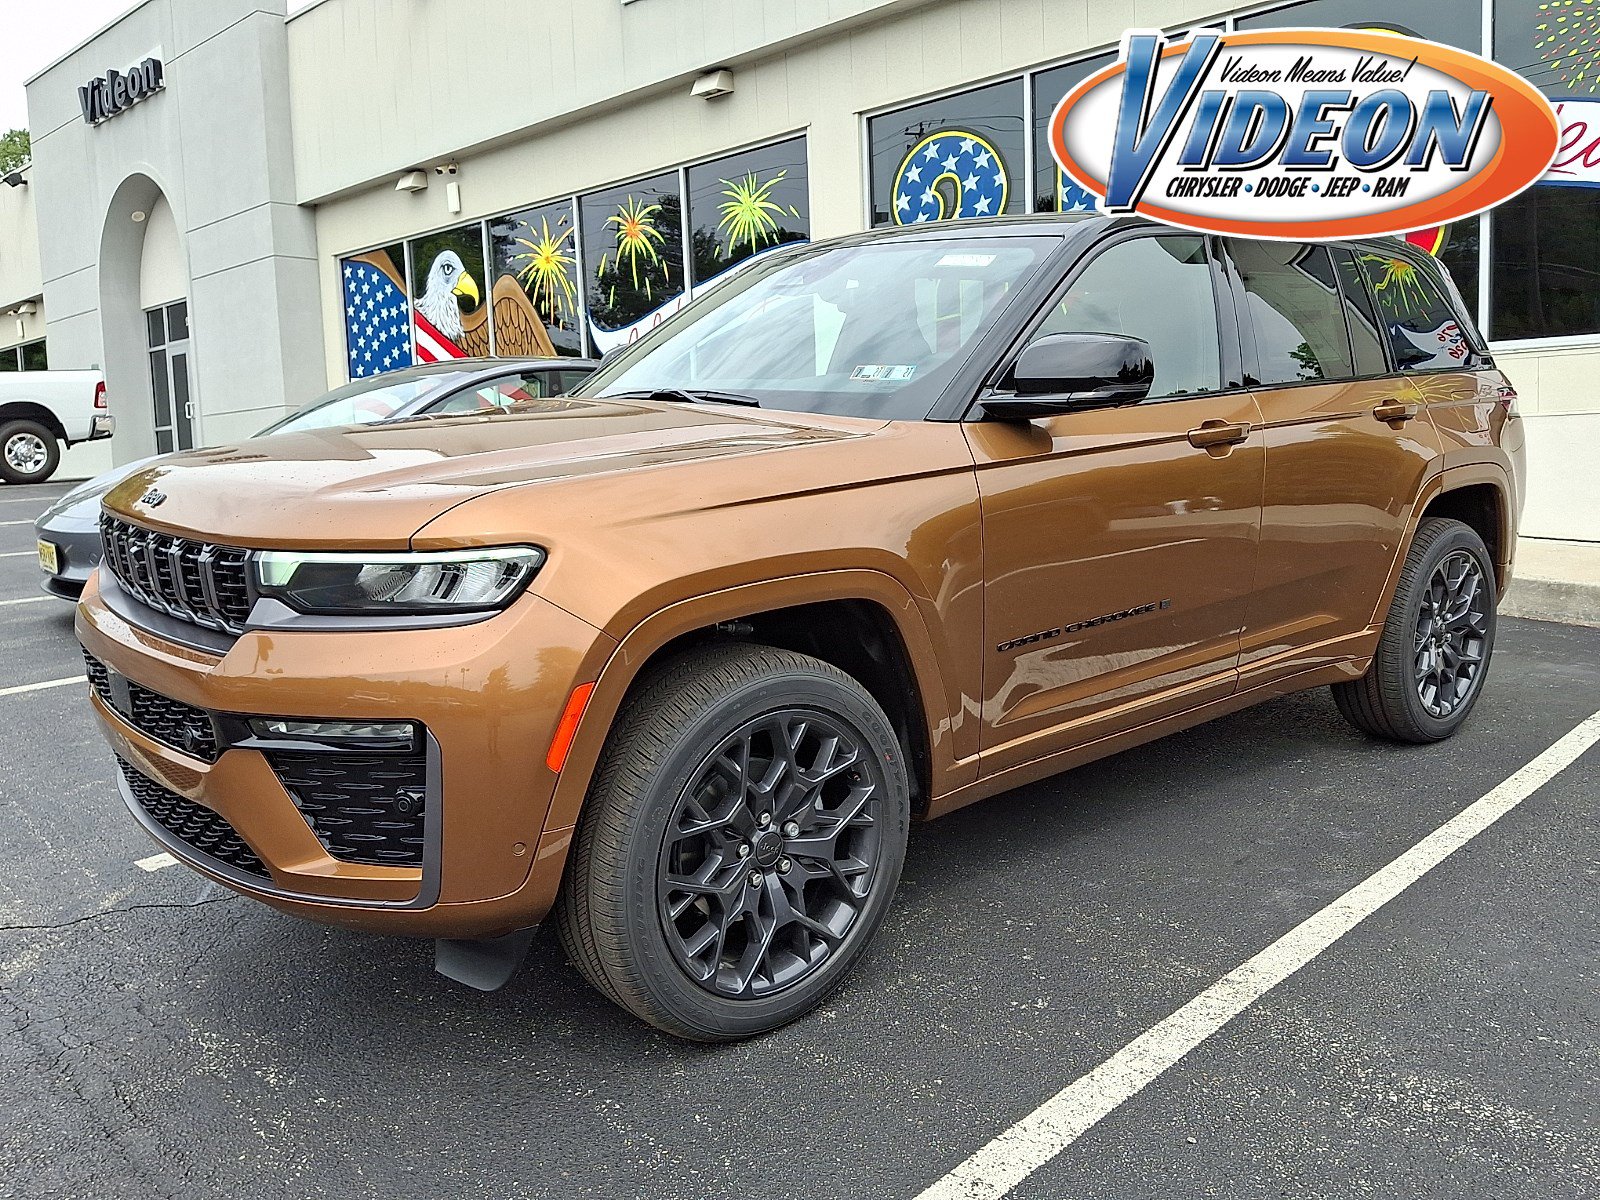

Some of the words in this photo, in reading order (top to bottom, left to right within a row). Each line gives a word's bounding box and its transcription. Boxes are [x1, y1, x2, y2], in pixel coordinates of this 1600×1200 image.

[77, 57, 164, 124] Videon
[997, 627, 1061, 652] GRAND
[1065, 602, 1156, 633] CHEROKEE
